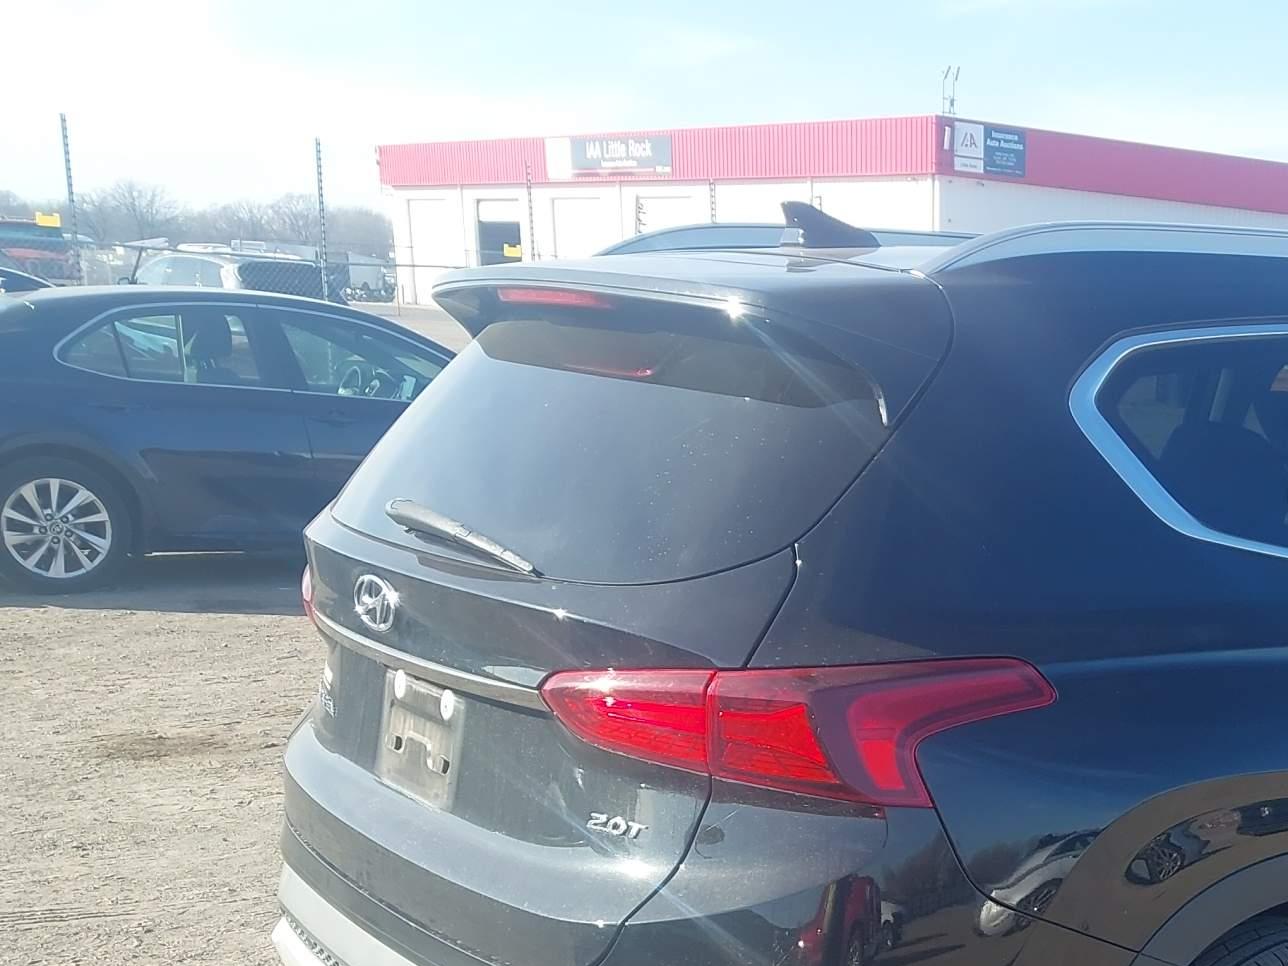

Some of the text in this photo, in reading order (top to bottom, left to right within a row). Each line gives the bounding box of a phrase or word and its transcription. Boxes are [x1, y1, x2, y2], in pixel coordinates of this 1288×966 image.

[585, 138, 652, 159] IAA Little Rock
